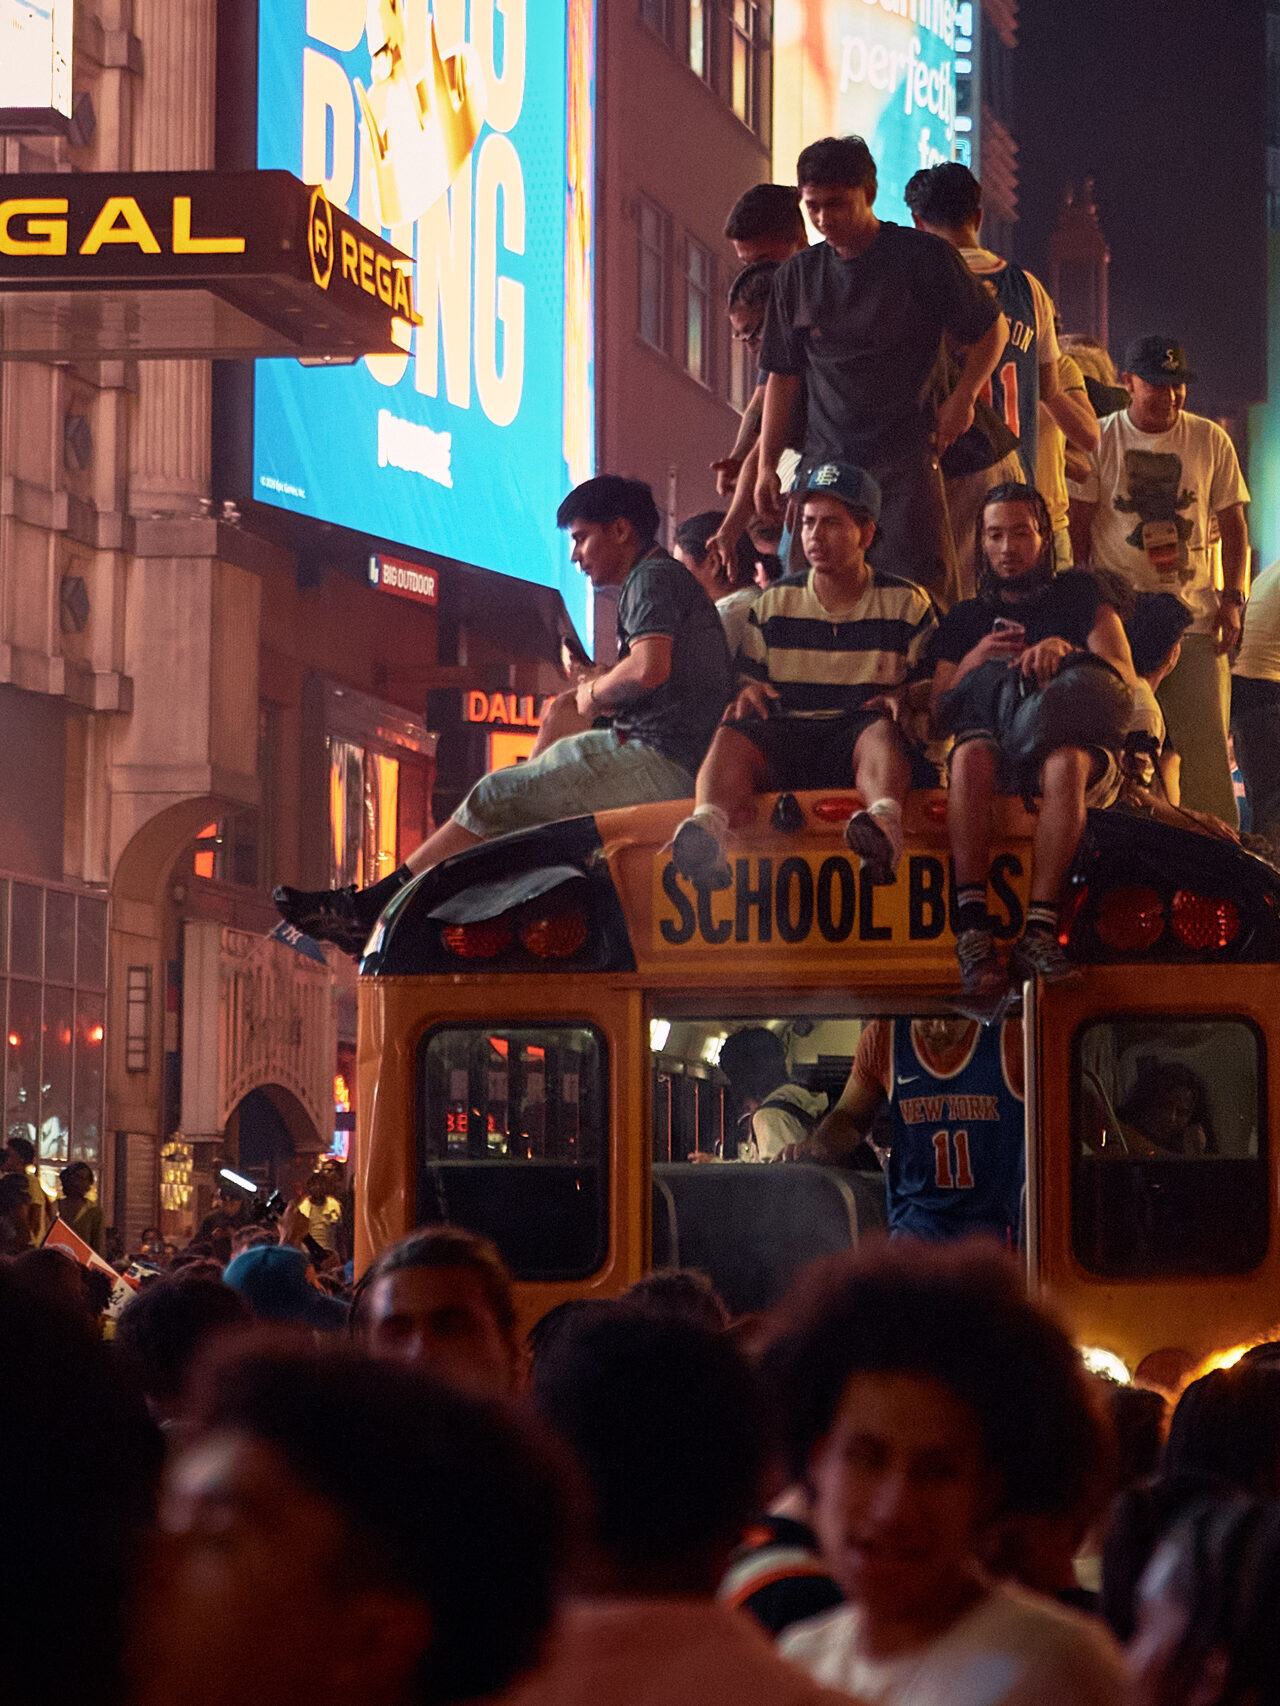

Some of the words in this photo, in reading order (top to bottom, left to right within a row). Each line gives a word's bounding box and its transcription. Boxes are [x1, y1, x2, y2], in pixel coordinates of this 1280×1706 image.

[0, 196, 246, 256] GAL
[341, 229, 424, 327] REGAL
[383, 564, 397, 586] BIG
[398, 568, 435, 598] OUTDOOR
[467, 690, 556, 728] DALL
[659, 855, 894, 946] SCHOOL
[898, 1095, 944, 1125] NEW
[945, 1093, 1000, 1121] YORK
[931, 1129, 975, 1189] 11
